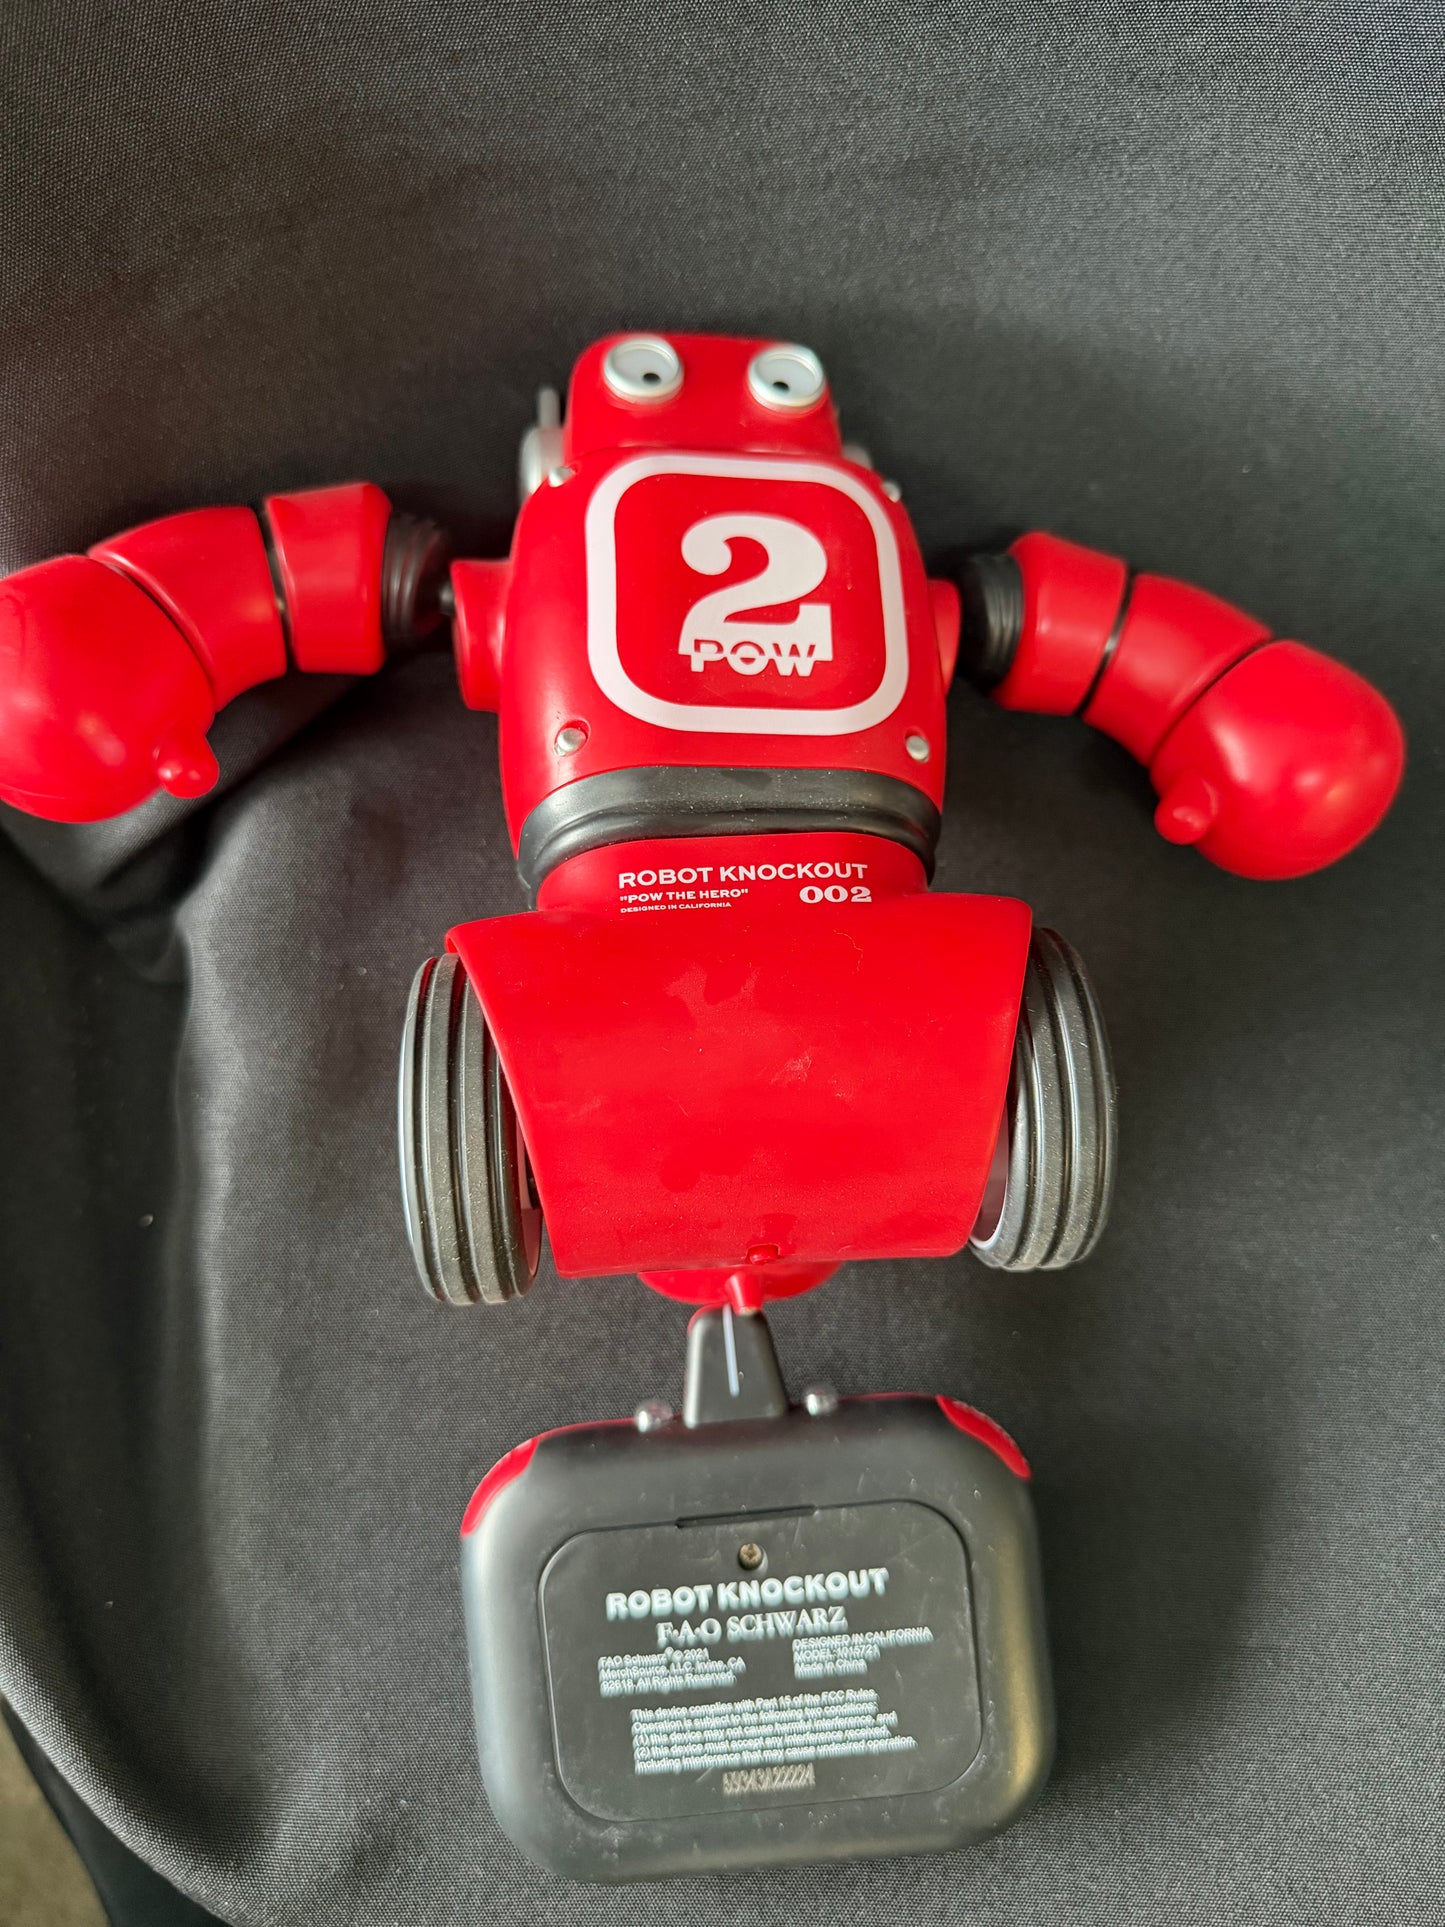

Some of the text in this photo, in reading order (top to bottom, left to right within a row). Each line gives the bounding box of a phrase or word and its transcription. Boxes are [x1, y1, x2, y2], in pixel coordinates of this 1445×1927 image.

[678, 514, 833, 661] 2
[691, 639, 816, 676] POW
[618, 862, 868, 888] ROBOT KNOCKOUT
[620, 888, 749, 903] "POW THE HERO"
[620, 904, 666, 913] DESIGNED
[679, 902, 732, 910] CALIFORNIA
[800, 885, 872, 903] 002
[606, 1567, 889, 1621] ROBOT KNOCKOUT
[726, 1606, 848, 1642] SCHWARZ
[792, 1627, 934, 1651] DESIGNED IN CALIFORNIA
[599, 1655, 623, 1669] FAO
[683, 1647, 709, 1661] 2021
[727, 1656, 747, 1672] CA
[794, 1659, 867, 1678] Made in China
[636, 1676, 651, 1693] All
[652, 1674, 684, 1693] Rights
[630, 1708, 654, 1722] This
[655, 1706, 687, 1720] device
[688, 1702, 733, 1718] complies
[733, 1699, 755, 1713] with
[755, 1697, 778, 1711] Part
[779, 1695, 792, 1708] 15
[792, 1693, 803, 1707] of
[804, 1693, 820, 1706] the
[821, 1690, 845, 1705] FCC
[632, 1719, 683, 1736] Operation
[693, 1714, 730, 1730] subject
[730, 1713, 741, 1725] to
[741, 1712, 758, 1724] the
[760, 1708, 803, 1723] following
[804, 1706, 823, 1719] two
[633, 1733, 650, 1748] (1)
[650, 1732, 669, 1745] this
[669, 1730, 702, 1743] device
[703, 1728, 724, 1742] may
[725, 1725, 743, 1738] not
[744, 1724, 774, 1736] cause
[774, 1719, 813, 1735] harmful
[876, 1710, 898, 1726] and
[634, 1746, 651, 1761] (2)
[651, 1744, 669, 1758] this
[670, 1742, 703, 1756] device
[704, 1739, 730, 1753] must
[731, 1736, 764, 1751] accept
[764, 1735, 784, 1750] any
[784, 1730, 844, 1747] interference
[635, 1757, 681, 1774] including
[682, 1752, 741, 1770] interference
[741, 1749, 762, 1765] that
[762, 1748, 785, 1764] may
[785, 1746, 816, 1760] cause
[817, 1740, 867, 1757] undesired
